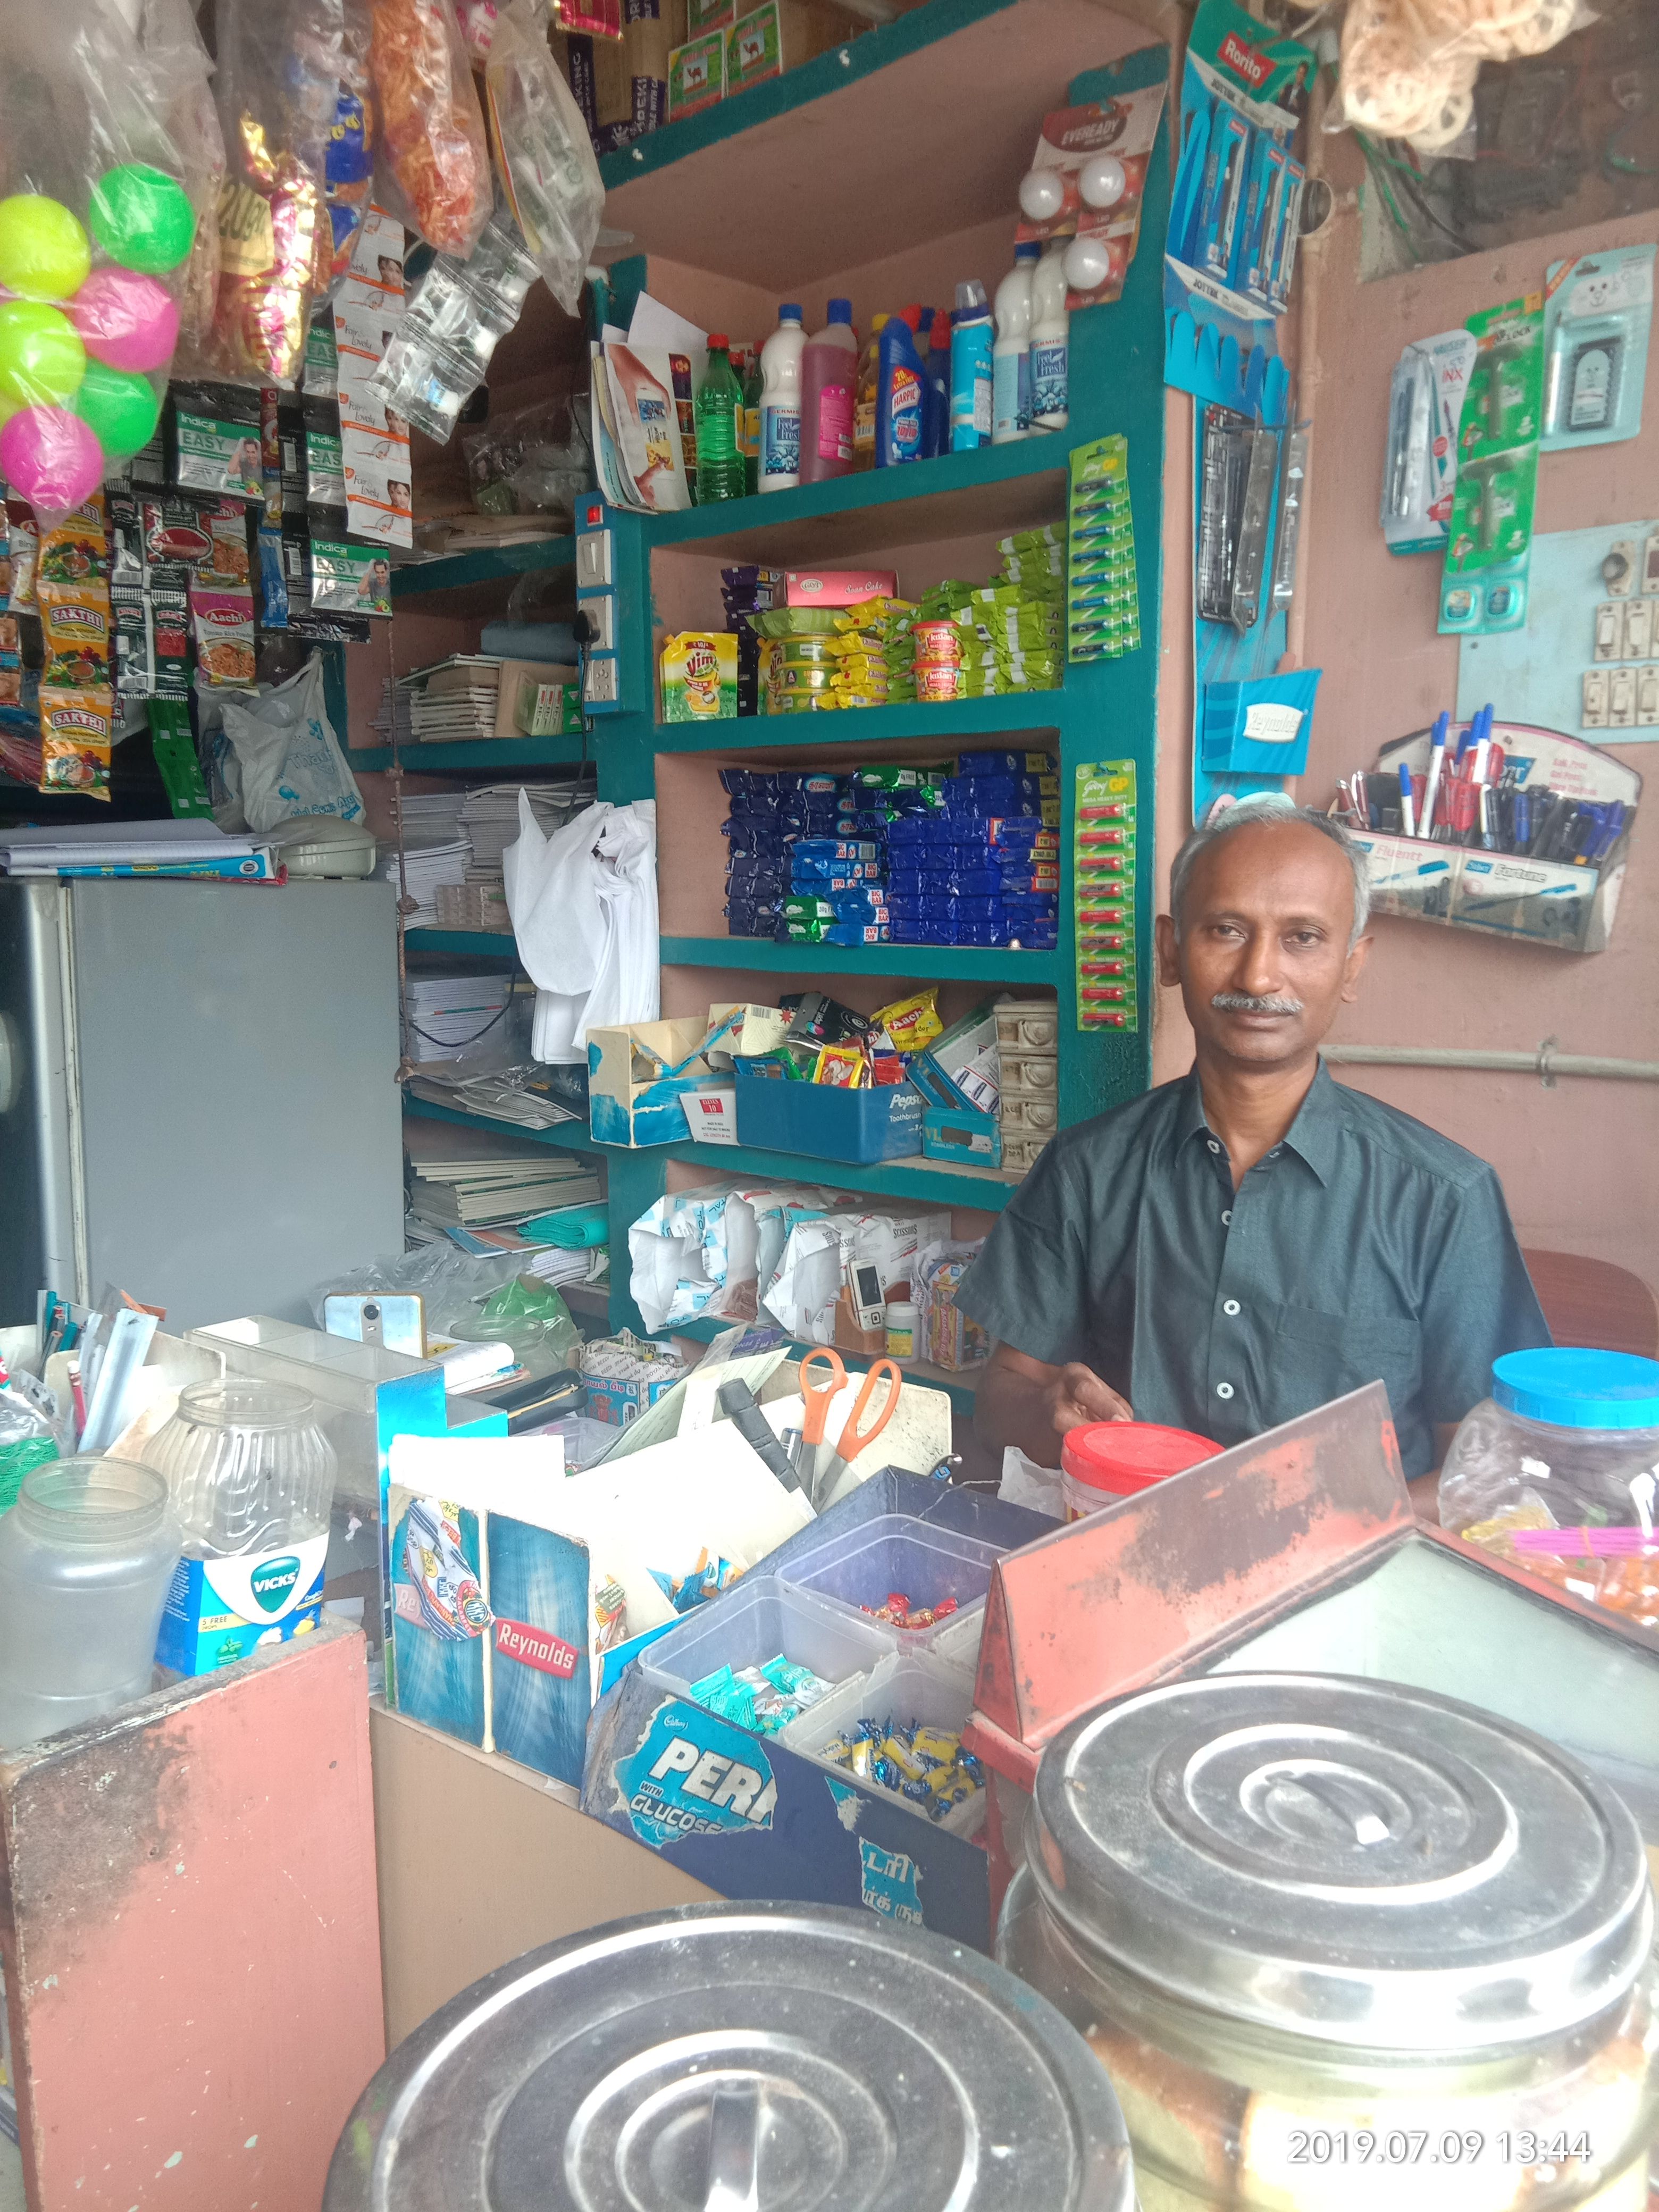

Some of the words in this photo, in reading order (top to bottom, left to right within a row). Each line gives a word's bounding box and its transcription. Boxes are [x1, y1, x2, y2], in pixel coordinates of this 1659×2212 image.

[1225, 38, 1261, 80] Rorito
[1061, 118, 1119, 146] EVEREADY
[1041, 361, 1066, 376] Fresh
[894, 387, 916, 408] HARPIC
[348, 400, 363, 411] Fair
[355, 412, 375, 425] Lovely
[183, 432, 225, 451] EASY
[353, 474, 367, 485] Fair
[361, 487, 380, 499] Lovely
[315, 542, 347, 555] Indica
[316, 559, 356, 574] EASY
[865, 581, 883, 592] Cake
[53, 609, 102, 628] SAKTHI
[210, 612, 244, 623] Aachi
[686, 651, 714, 677] Vim
[54, 713, 104, 734] SAKTHI
[1247, 712, 1299, 735] Reynolds
[1109, 777, 1129, 793] GP
[1376, 844, 1423, 862] Fluentt
[1494, 863, 1548, 883] Fortune
[893, 1224, 918, 1239] SCISSORS
[601, 1364, 613, 1376] BEEDI
[646, 1365, 661, 1379] ROYAL
[254, 1572, 296, 1593] VICKS
[210, 1615, 228, 1624] FREE
[498, 1623, 576, 1670] Reynolds
[663, 1714, 688, 1729] Cadbury
[640, 1781, 664, 1797] WITH
